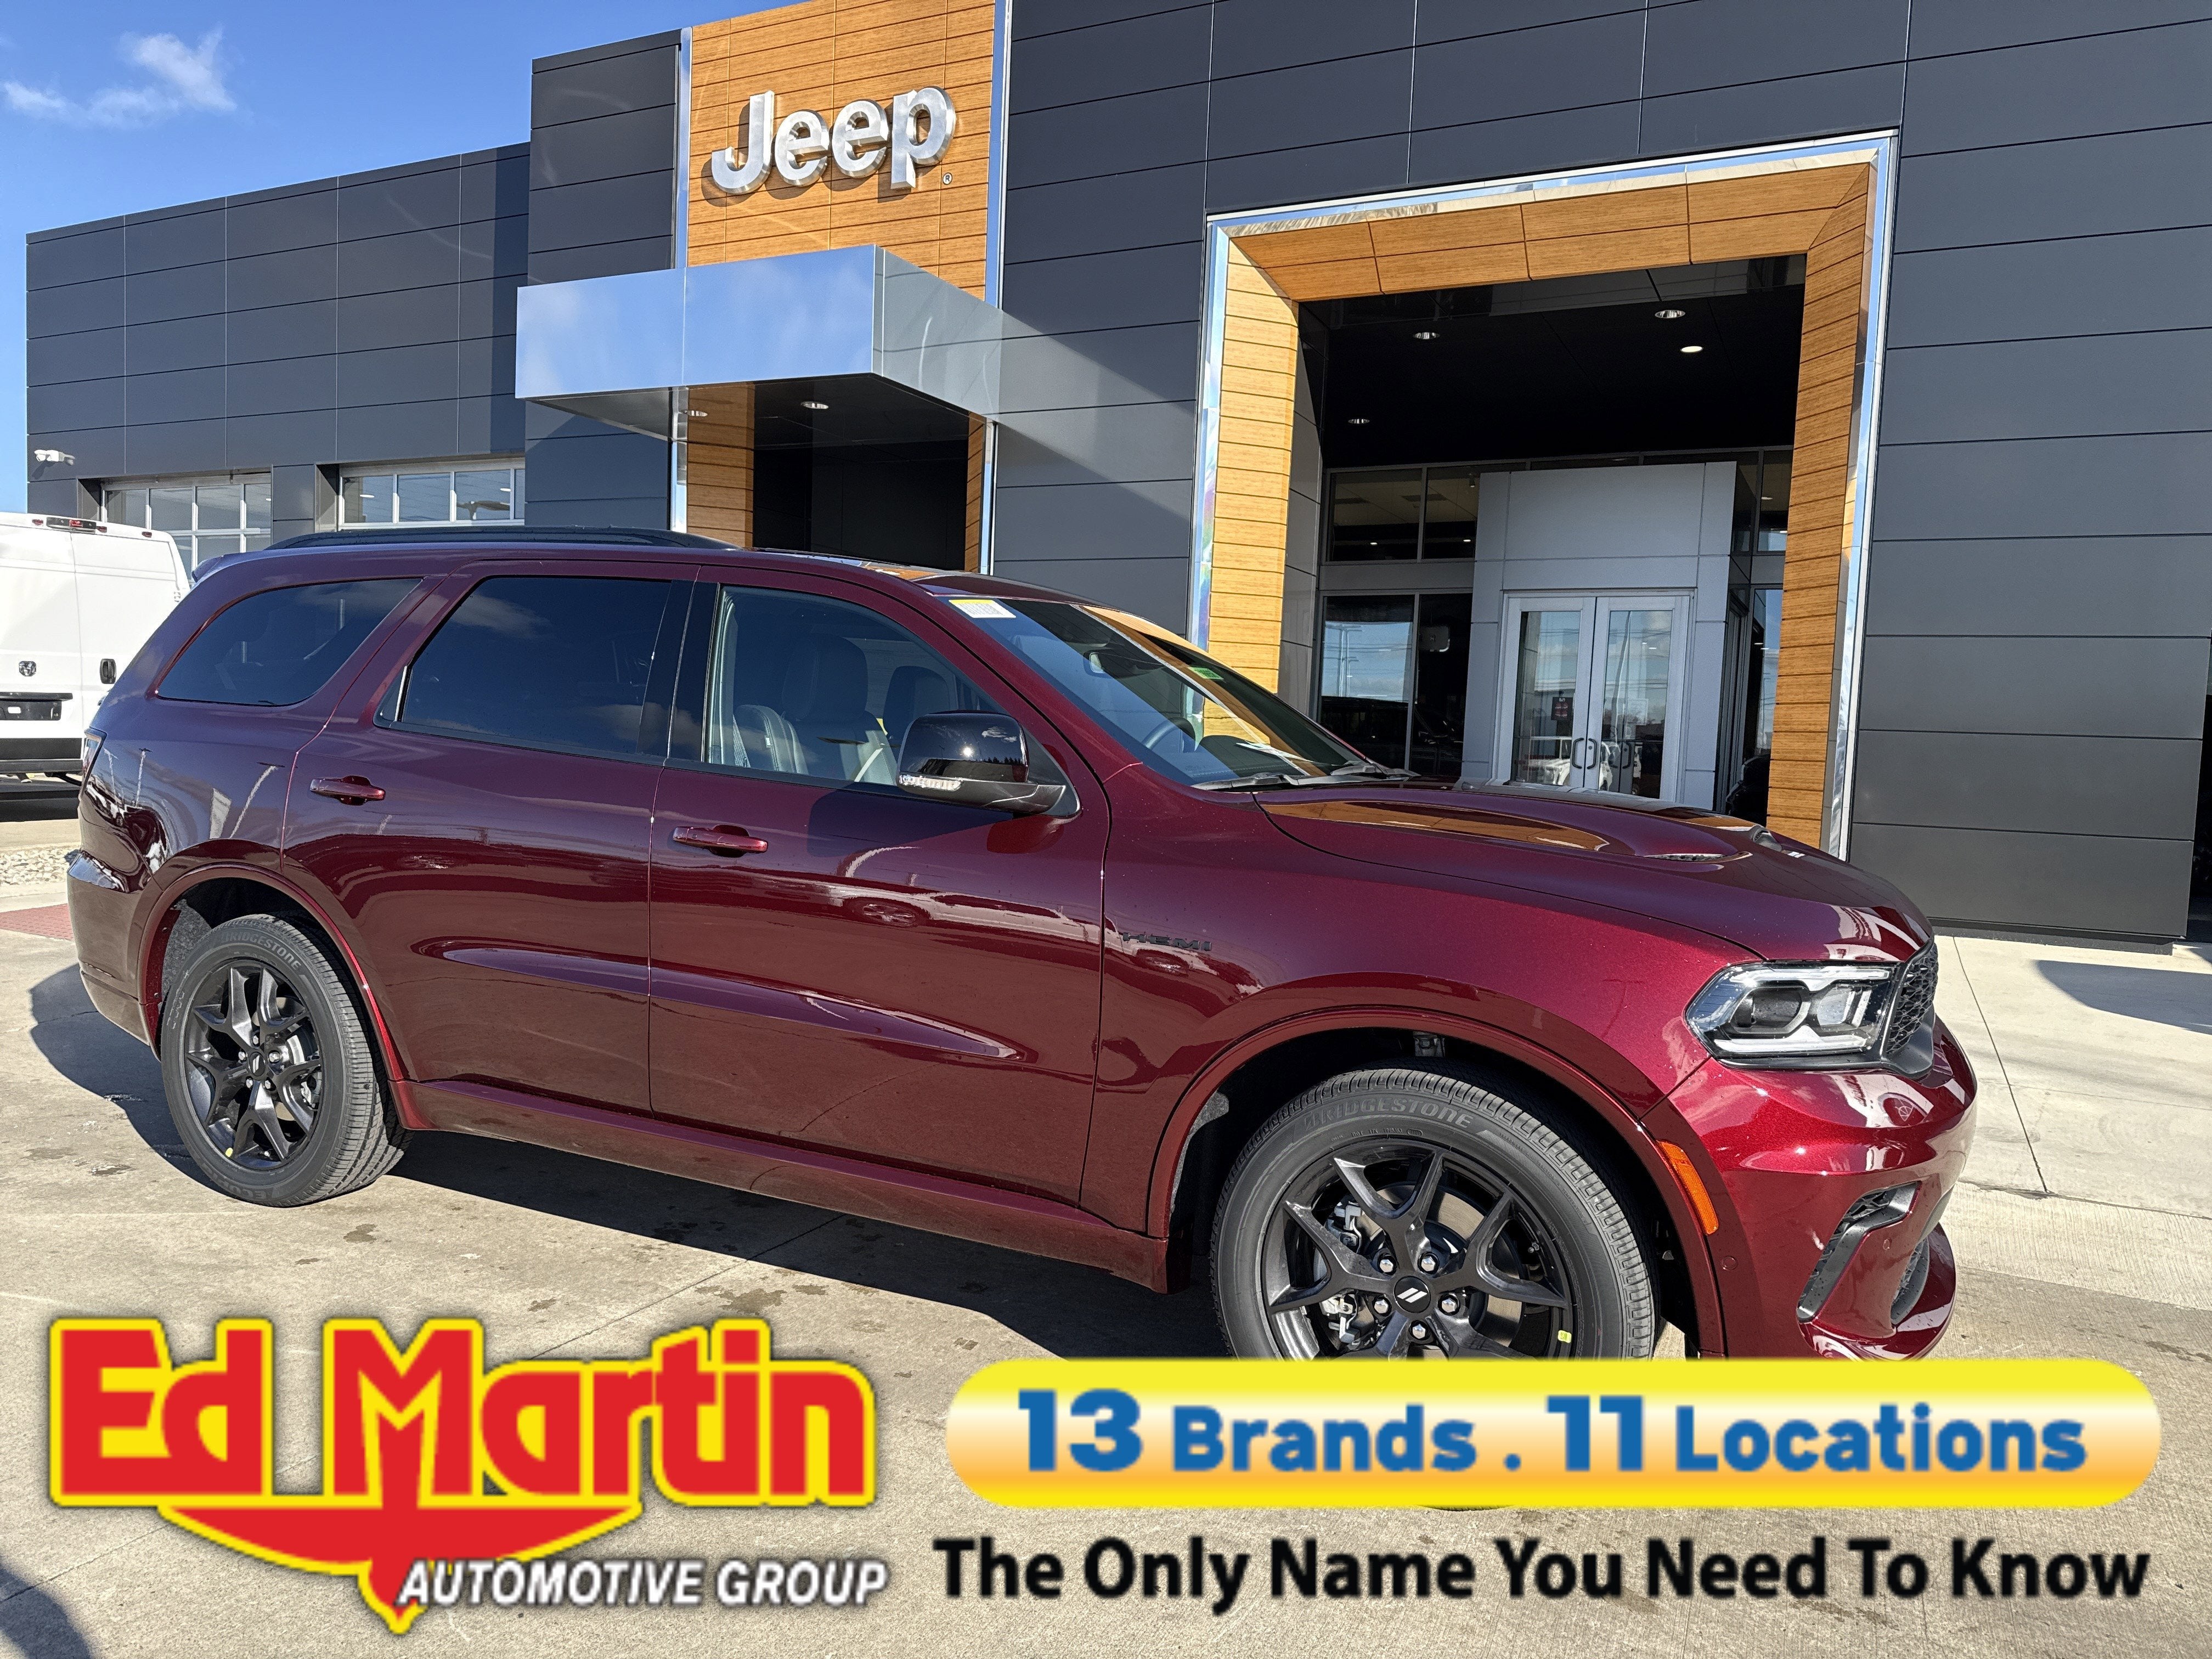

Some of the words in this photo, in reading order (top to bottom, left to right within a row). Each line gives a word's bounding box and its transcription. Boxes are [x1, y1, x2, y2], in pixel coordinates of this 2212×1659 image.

[712, 86, 956, 195] Jeep
[1123, 932, 1211, 951] HEMI
[1304, 1097, 1475, 1130] BRIDGESTONE
